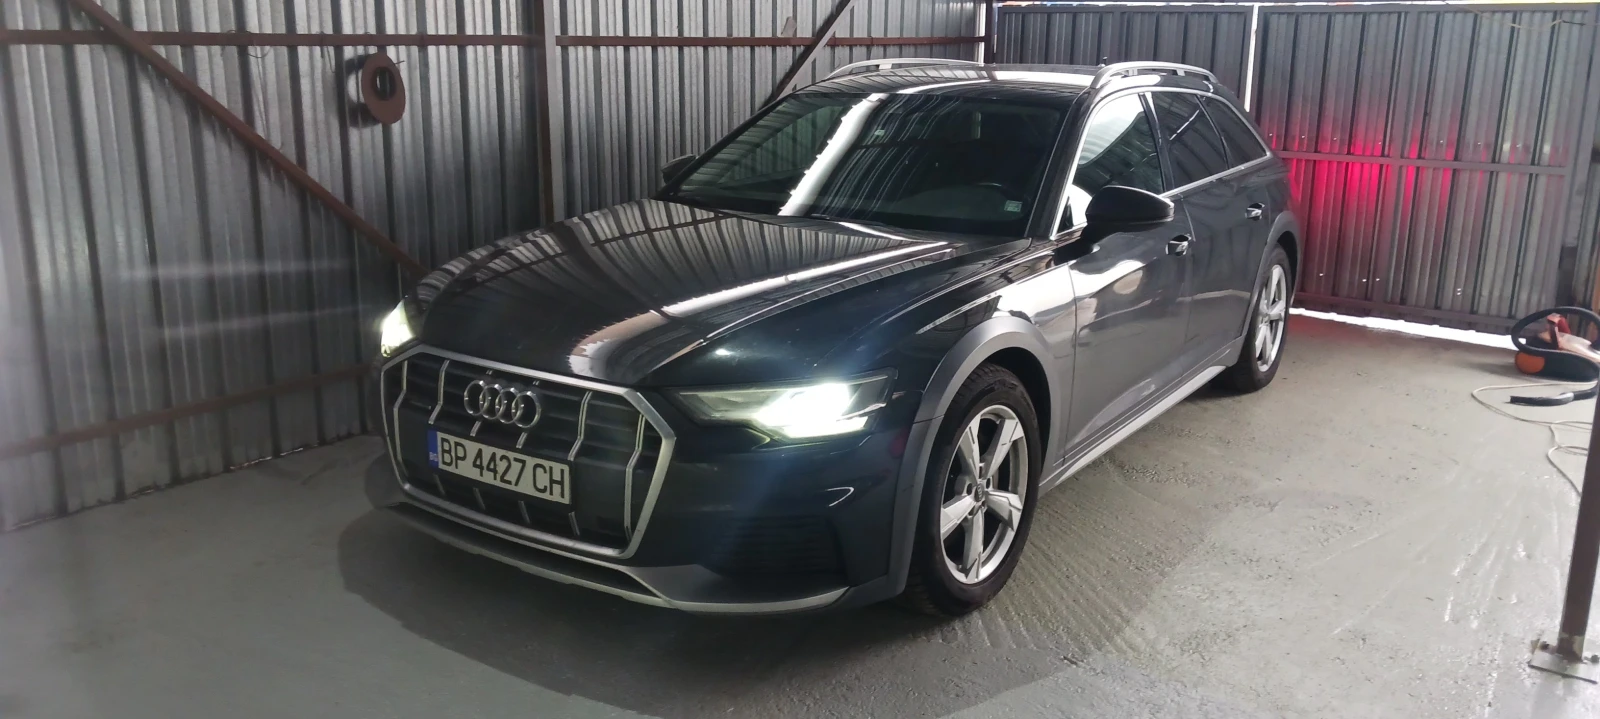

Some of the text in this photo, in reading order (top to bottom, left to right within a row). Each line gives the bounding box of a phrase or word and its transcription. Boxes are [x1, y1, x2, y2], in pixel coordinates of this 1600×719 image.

[440, 437, 565, 499] BP 4427 CH
